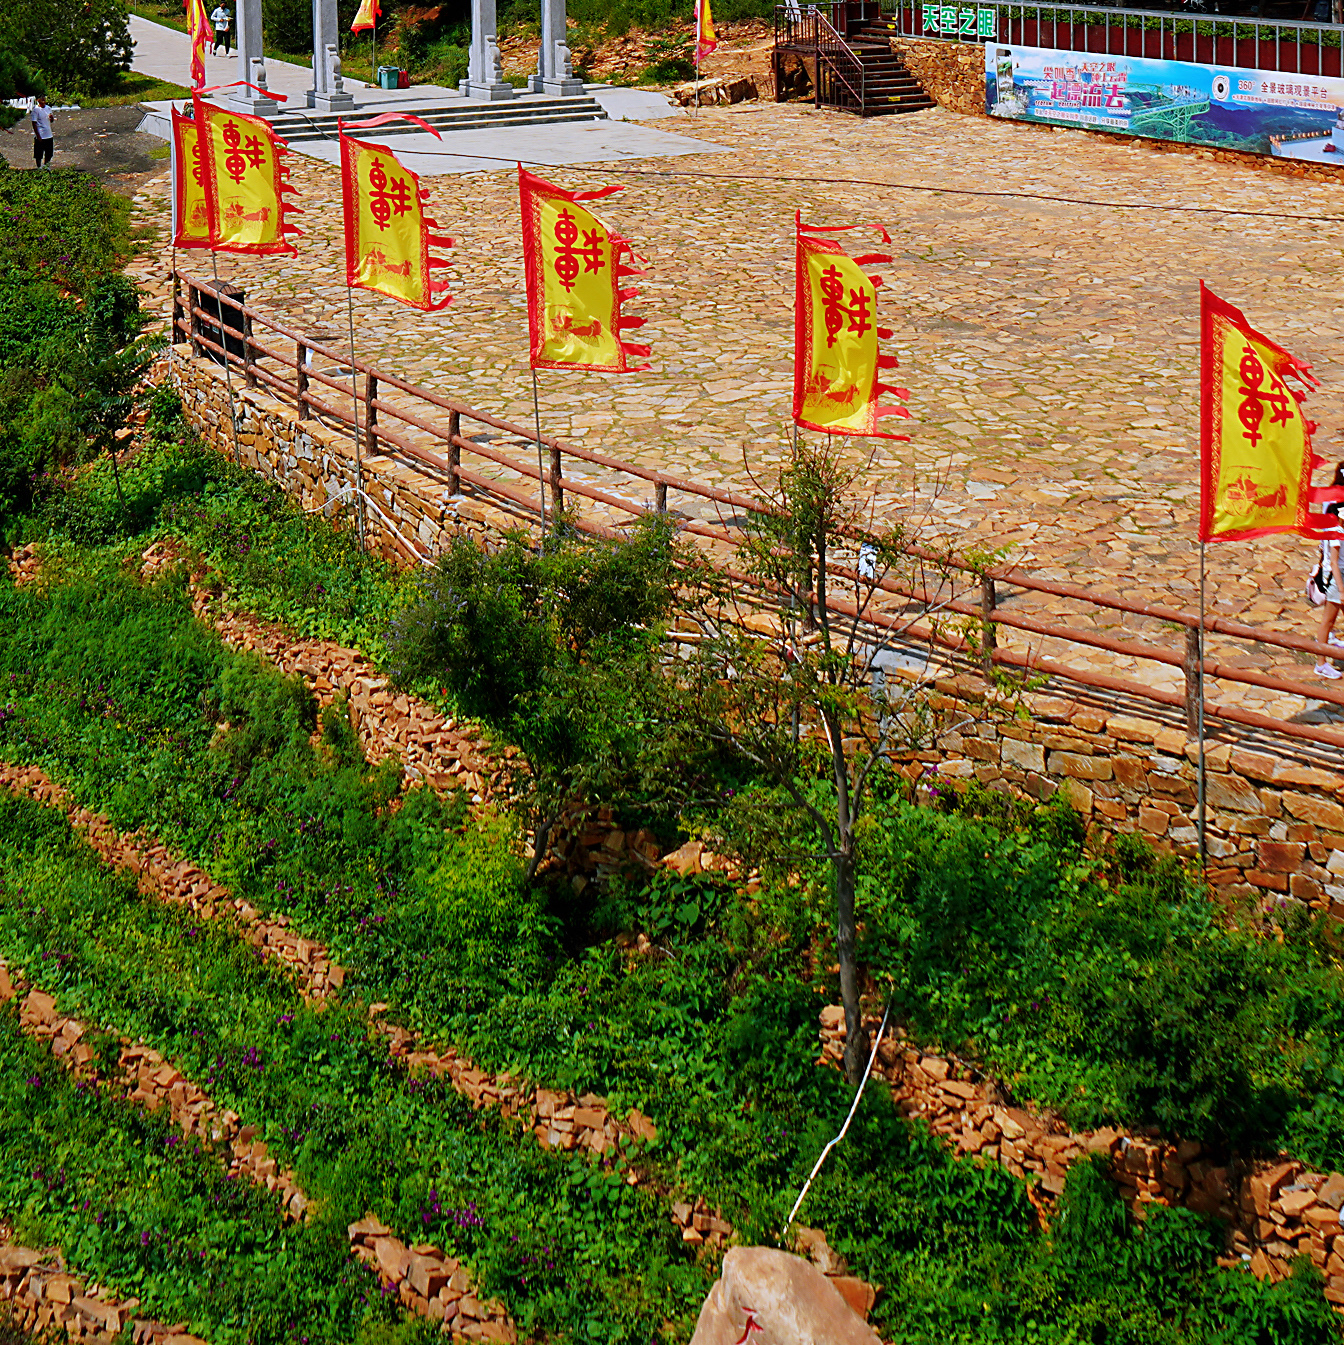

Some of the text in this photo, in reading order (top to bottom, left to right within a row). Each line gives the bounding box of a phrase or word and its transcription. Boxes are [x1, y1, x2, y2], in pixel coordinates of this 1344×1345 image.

[922, 3, 996, 37] 天空之眼
[1034, 81, 1126, 108] 一起漂流去
[1260, 81, 1328, 99] 全景玻璃观景平台
